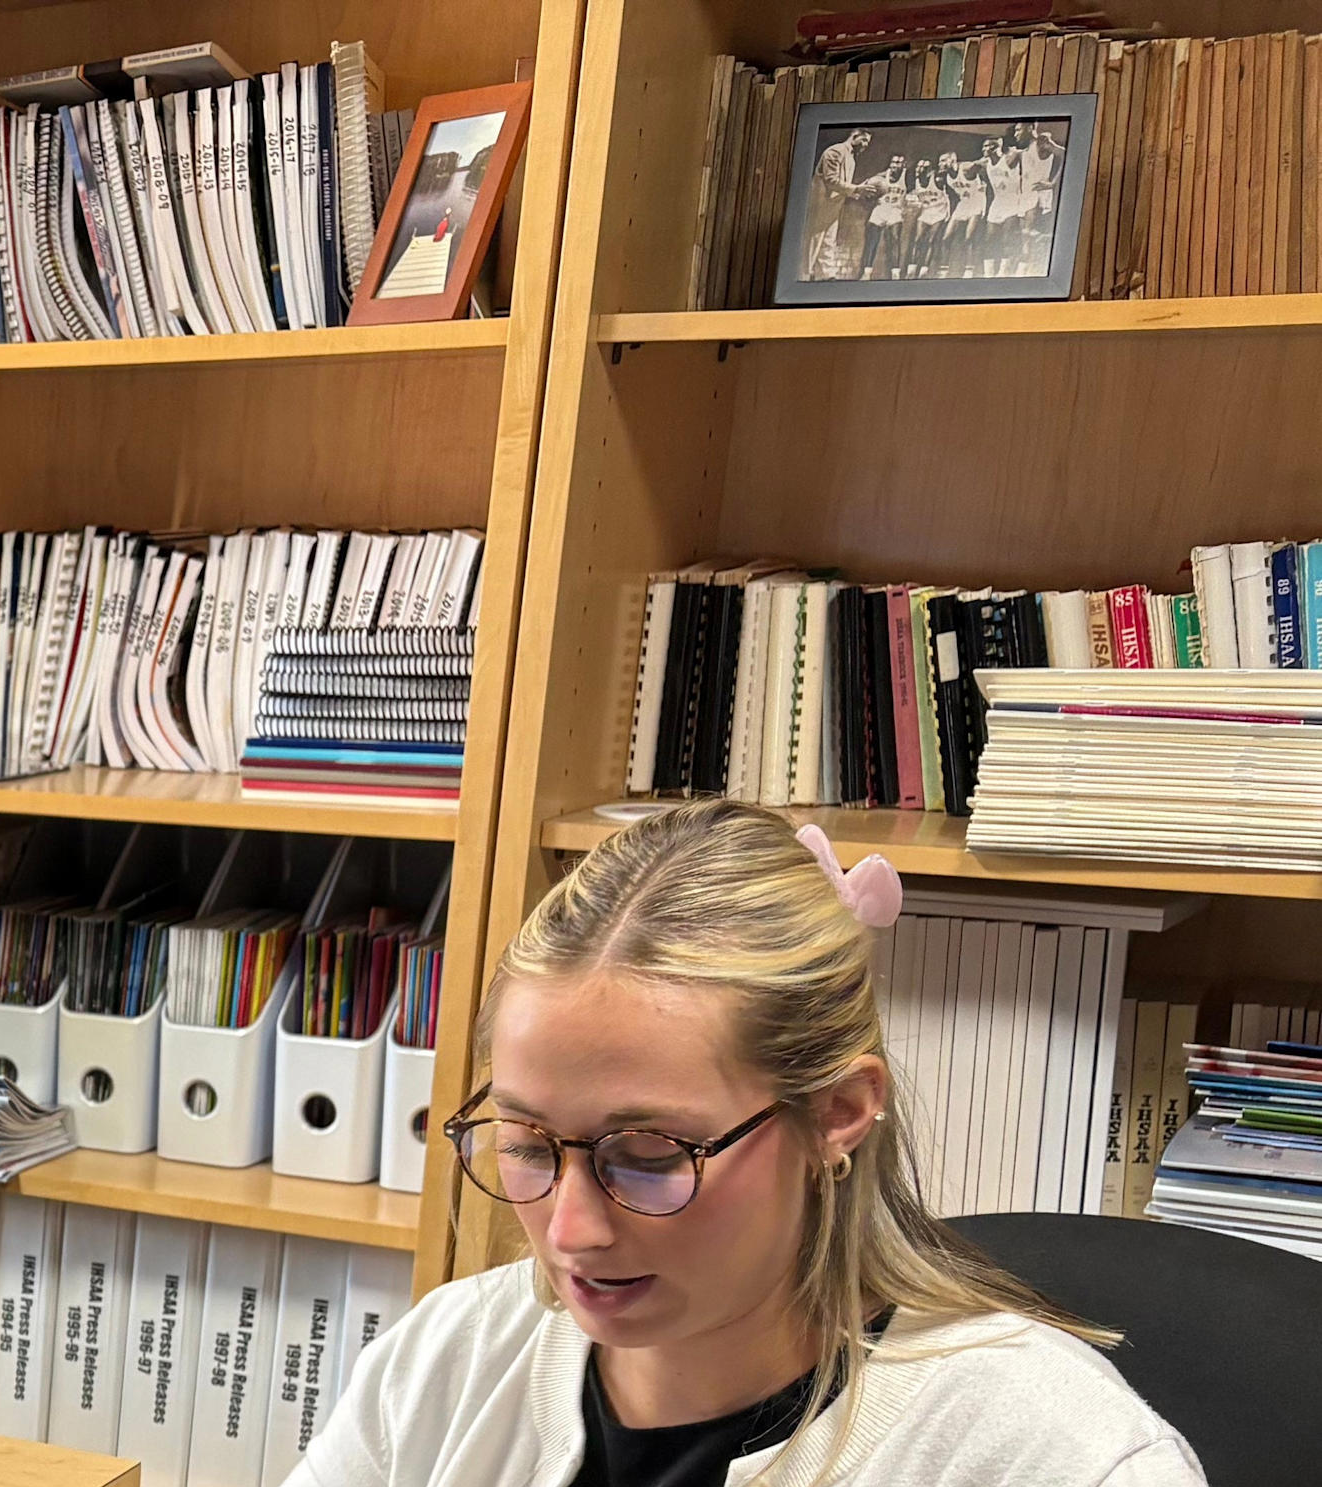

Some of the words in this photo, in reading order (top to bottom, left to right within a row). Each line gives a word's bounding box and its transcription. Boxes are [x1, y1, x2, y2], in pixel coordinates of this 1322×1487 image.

[284, 116, 296, 163] 2016-17
[1114, 591, 1134, 607] 85
[1179, 600, 1199, 615] 86
[1277, 578, 1289, 595] 89
[1279, 615, 1295, 667] IHSAA
[1105, 1093, 1122, 1162] IHSAA
[1132, 1094, 1152, 1164] IHSAA
[21, 1255, 35, 1295] IHSAA
[89, 1262, 104, 1301] IHSAA
[163, 1274, 179, 1314] IHSAA
[0, 1298, 14, 1352] 1994-95
[19, 1298, 32, 1335] Press
[87, 1305, 101, 1343] Press
[239, 1285, 257, 1327] IHSAA
[311, 1299, 329, 1339] IHSAA
[65, 1306, 81, 1361] 1995-96
[138, 1319, 155, 1374] 1996-97
[160, 1317, 175, 1358] Press
[234, 1331, 251, 1370] Press
[359, 1313, 379, 1348] Mas
[15, 1339, 29, 1400] Releases
[82, 1347, 97, 1409] Releases
[212, 1332, 230, 1386] 1997-98
[283, 1344, 300, 1401] 1998-99
[306, 1342, 323, 1383] Press
[154, 1361, 171, 1423] Releases
[226, 1373, 246, 1437] Releases
